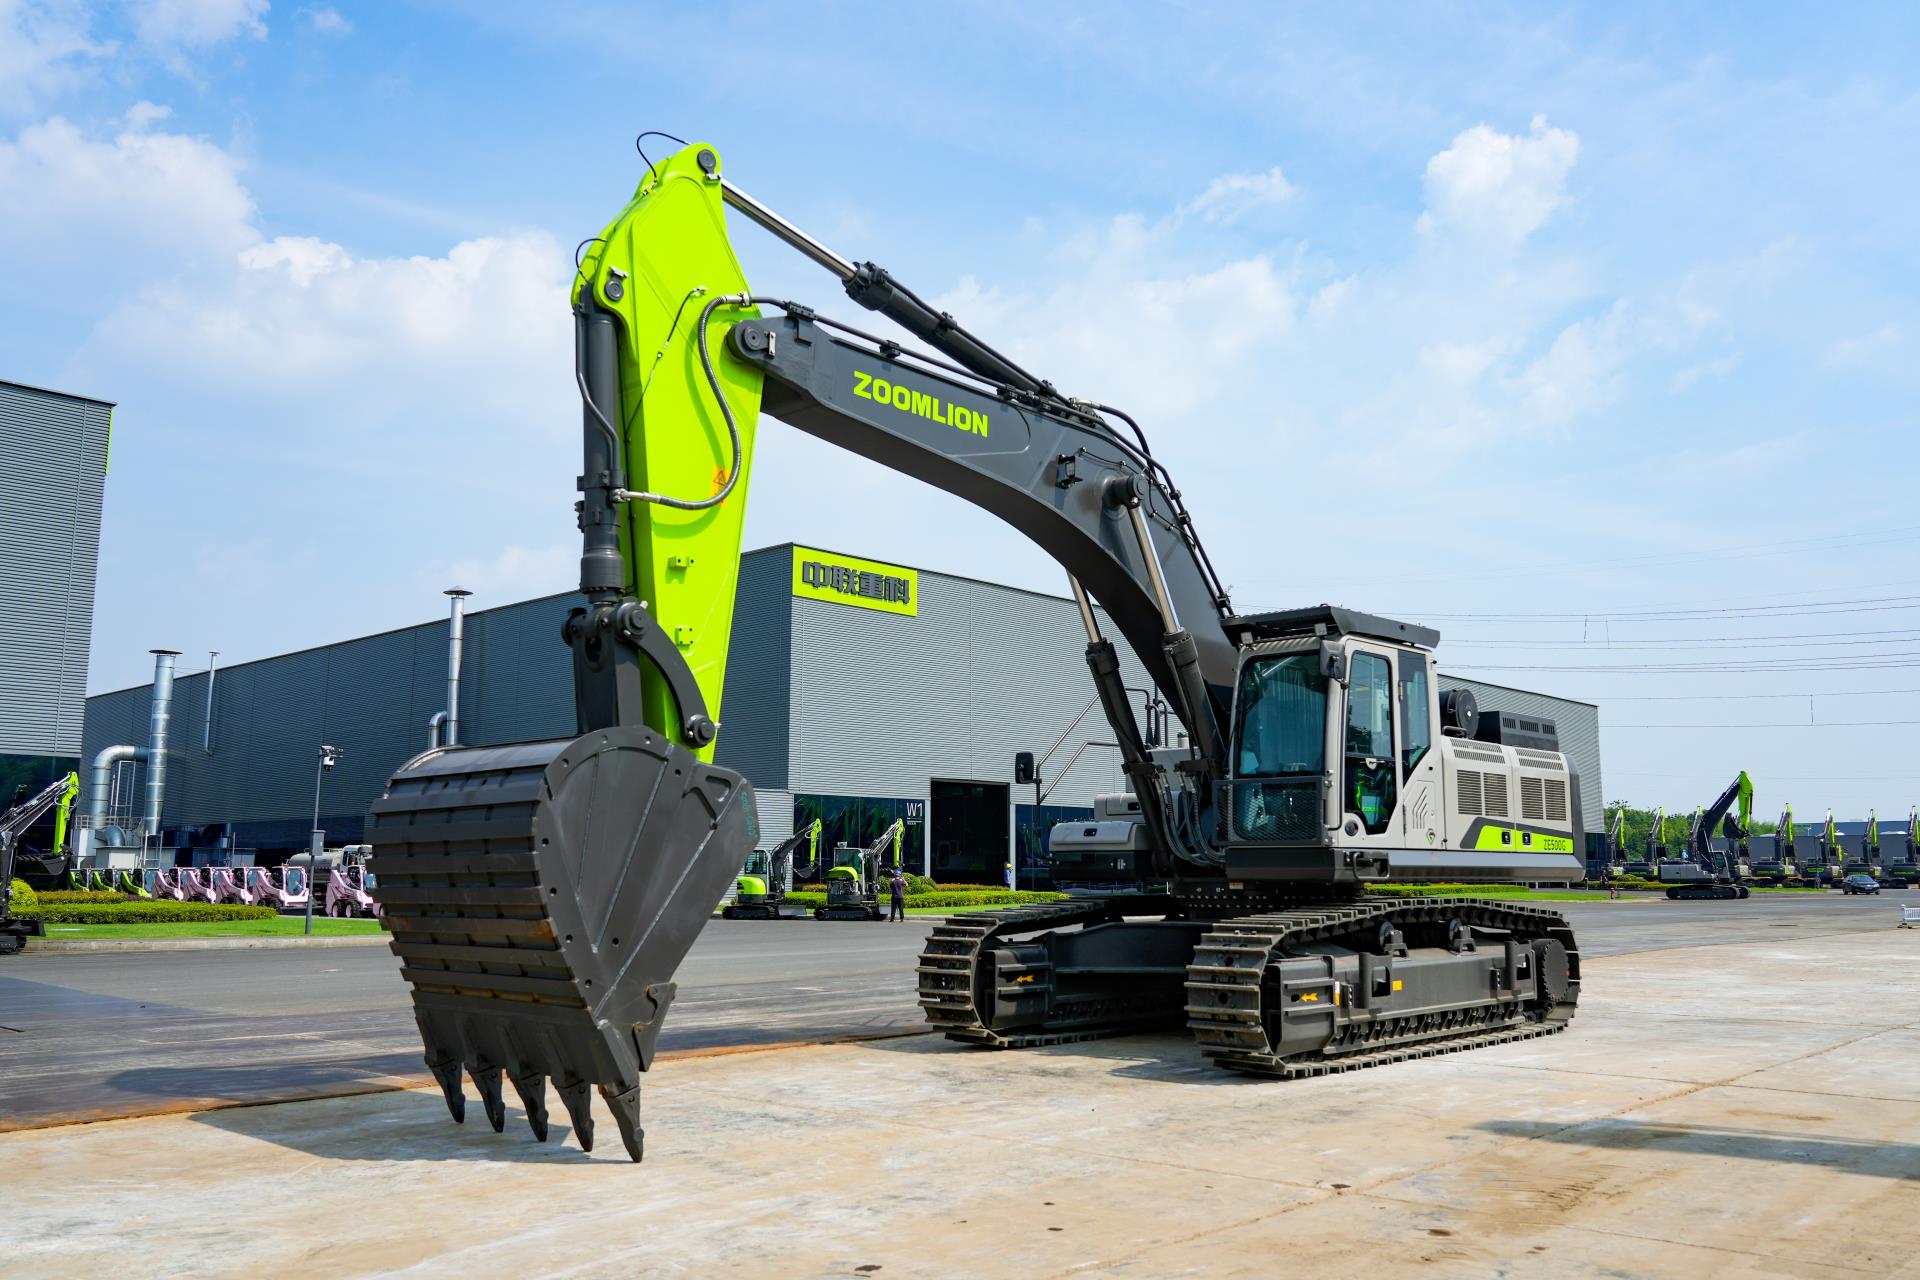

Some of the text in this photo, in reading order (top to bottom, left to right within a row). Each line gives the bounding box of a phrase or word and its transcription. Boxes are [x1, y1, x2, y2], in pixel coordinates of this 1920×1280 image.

[853, 370, 988, 437] ZOOMLION
[802, 561, 910, 604] 中联重科
[906, 802, 923, 817] W1
[1543, 839, 1566, 851] ZE500G
